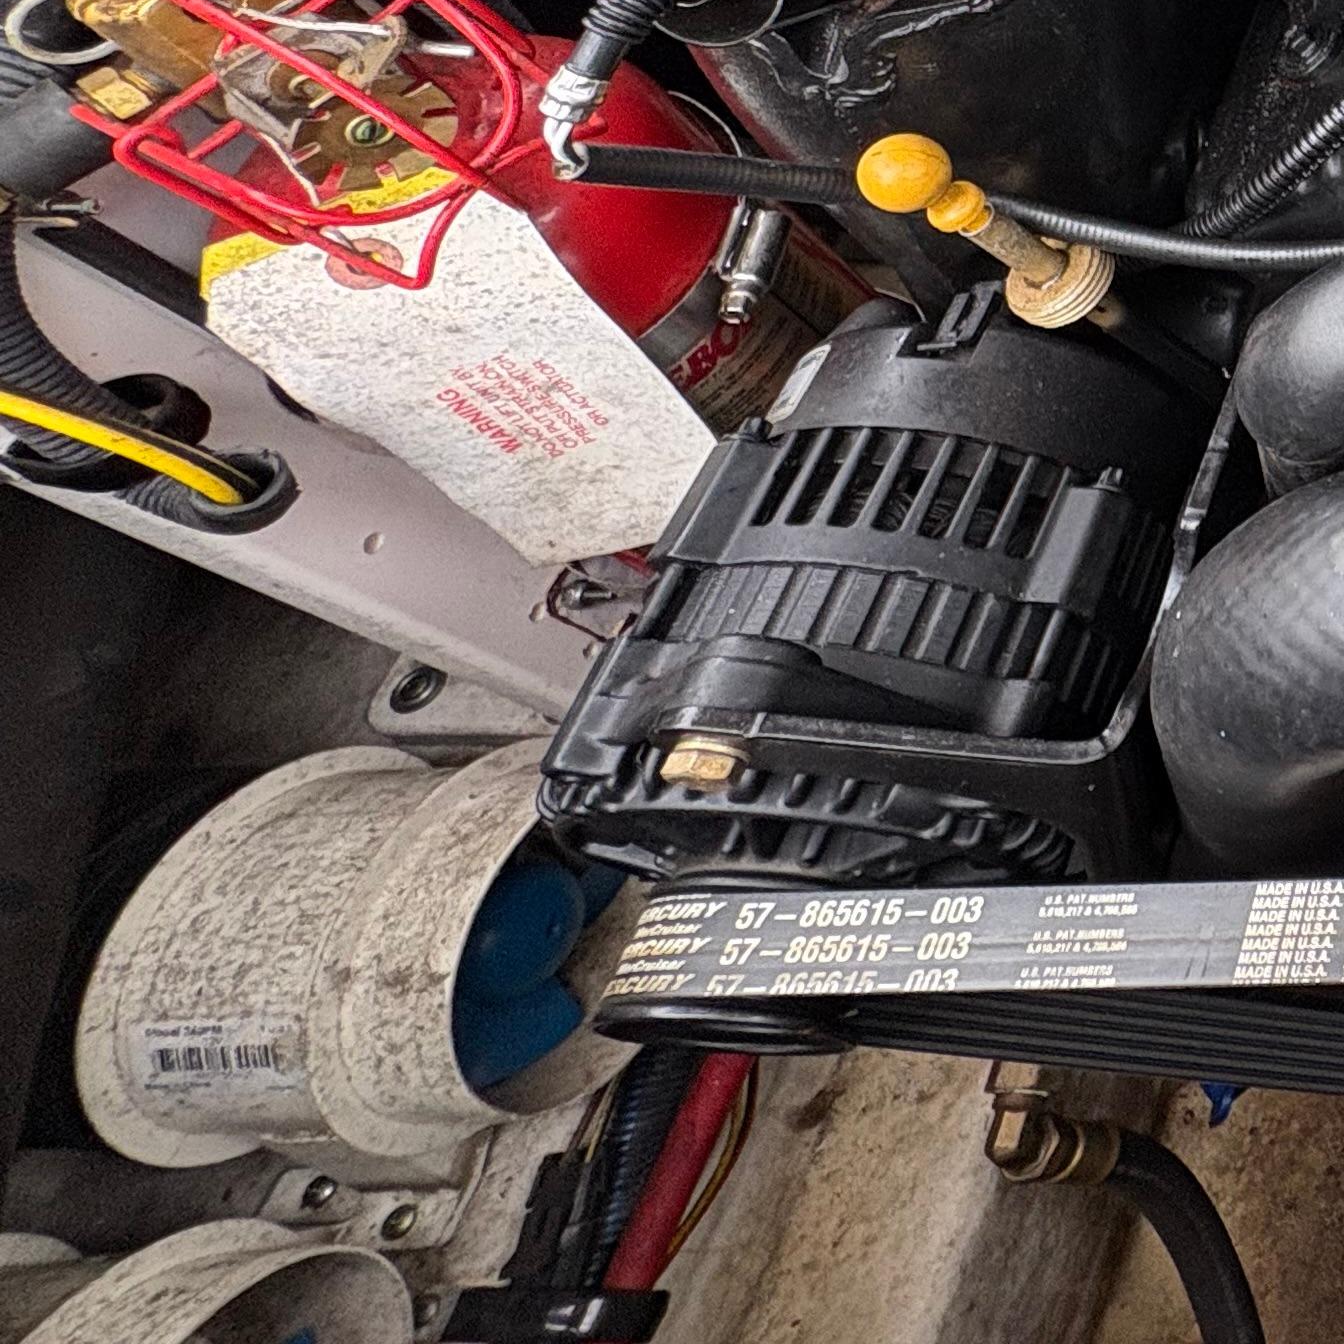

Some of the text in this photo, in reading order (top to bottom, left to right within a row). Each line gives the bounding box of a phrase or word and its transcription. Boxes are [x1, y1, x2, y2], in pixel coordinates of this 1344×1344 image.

[466, 381, 500, 404] UNIT
[491, 354, 597, 445] PRESSURE SWITCH
[495, 378, 537, 415] STRAIN
[532, 358, 610, 427] OR ACTUATOR
[436, 387, 524, 454] WARNING
[494, 404, 525, 425] LIFT
[532, 413, 561, 434] PUT
[515, 423, 545, 443] NOT
[554, 433, 579, 449] OR
[1255, 883, 1293, 895] MADE
[1295, 882, 1308, 895] IN
[1252, 897, 1289, 909] MADE
[1291, 896, 1306, 909] IN
[1308, 895, 1343, 908] U.S.A.
[734, 896, 985, 931] 57-865615-003
[1249, 911, 1286, 923] MADE
[1288, 910, 1303, 922] IN
[1304, 910, 1340, 921] U.S.A.
[1245, 925, 1283, 937] MADE
[1285, 924, 1299, 935] IN
[1301, 923, 1337, 935] U.S.A.
[718, 931, 973, 966] 57-865615-003
[1241, 938, 1279, 950] MADE
[1281, 937, 1296, 949] IN
[1297, 936, 1334, 949] U.S.A.
[1237, 952, 1276, 964] MADE
[1278, 951, 1293, 963] IN
[1294, 950, 1331, 963] U.S.A.
[1234, 966, 1272, 979] MADE
[1274, 965, 1289, 977] IN
[1291, 964, 1327, 977] U.S.A.
[602, 973, 696, 998] ERCURY
